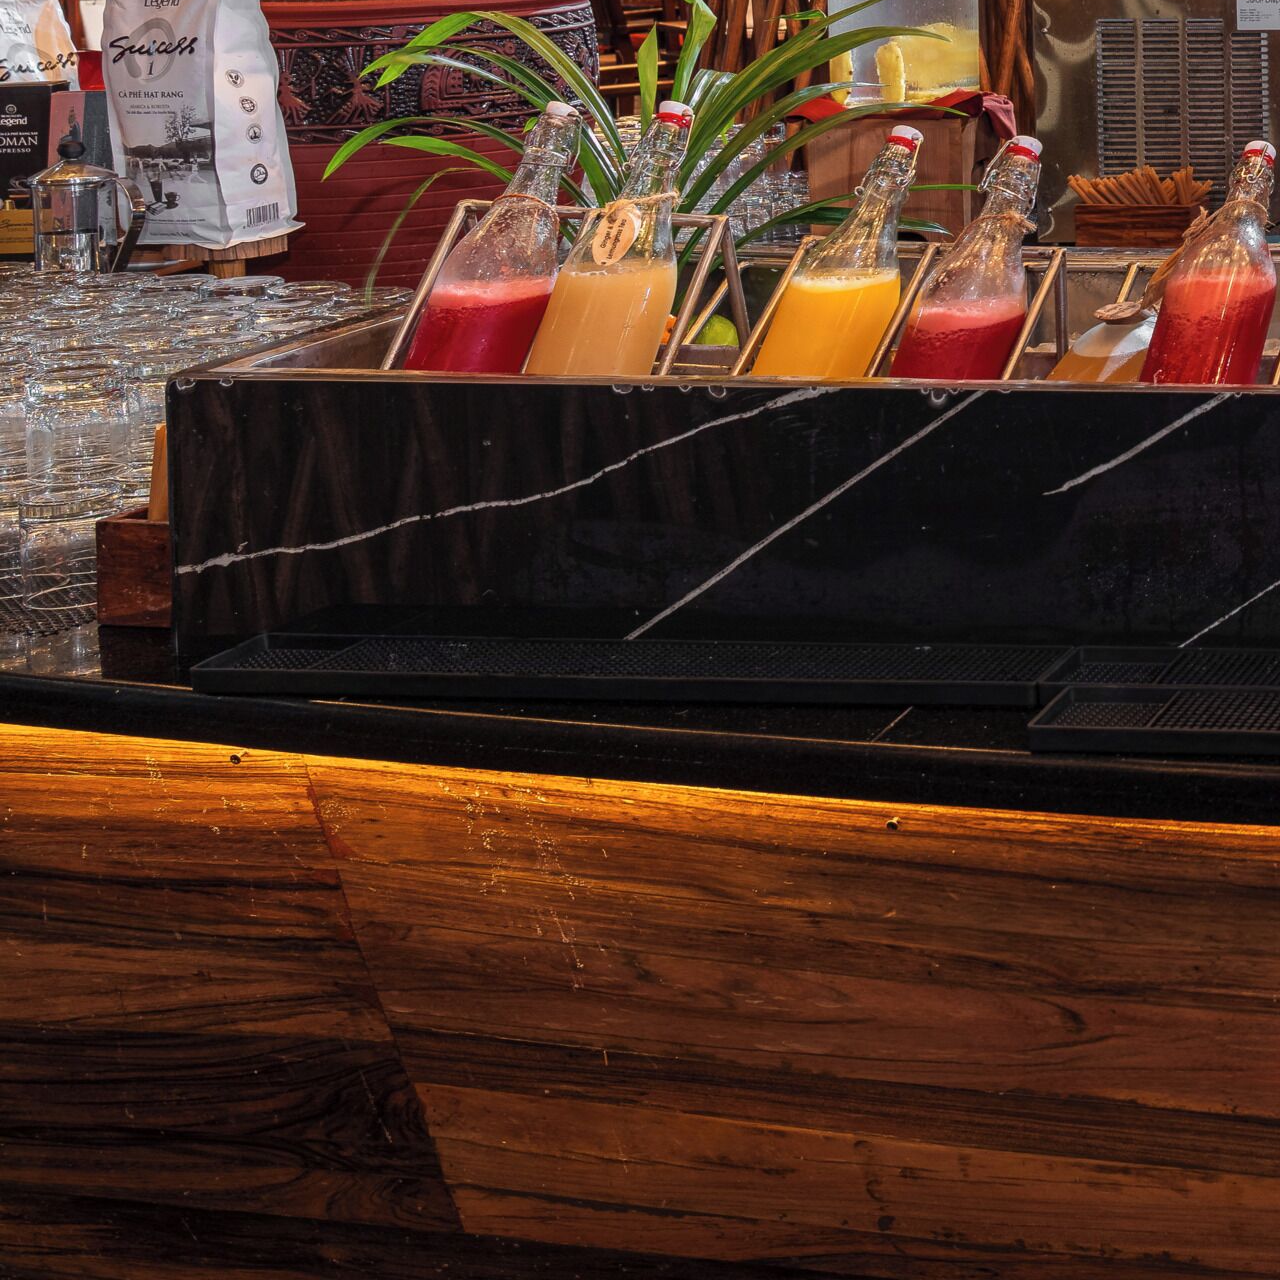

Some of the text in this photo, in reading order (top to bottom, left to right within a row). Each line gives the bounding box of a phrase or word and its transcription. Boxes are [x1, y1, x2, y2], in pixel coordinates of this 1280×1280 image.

[147, 61, 154, 75] 1
[0, 116, 28, 126] egend
[0, 135, 38, 147] OMAN
[600, 230, 612, 249] Ginger
[606, 229, 623, 259] Lemongrass
